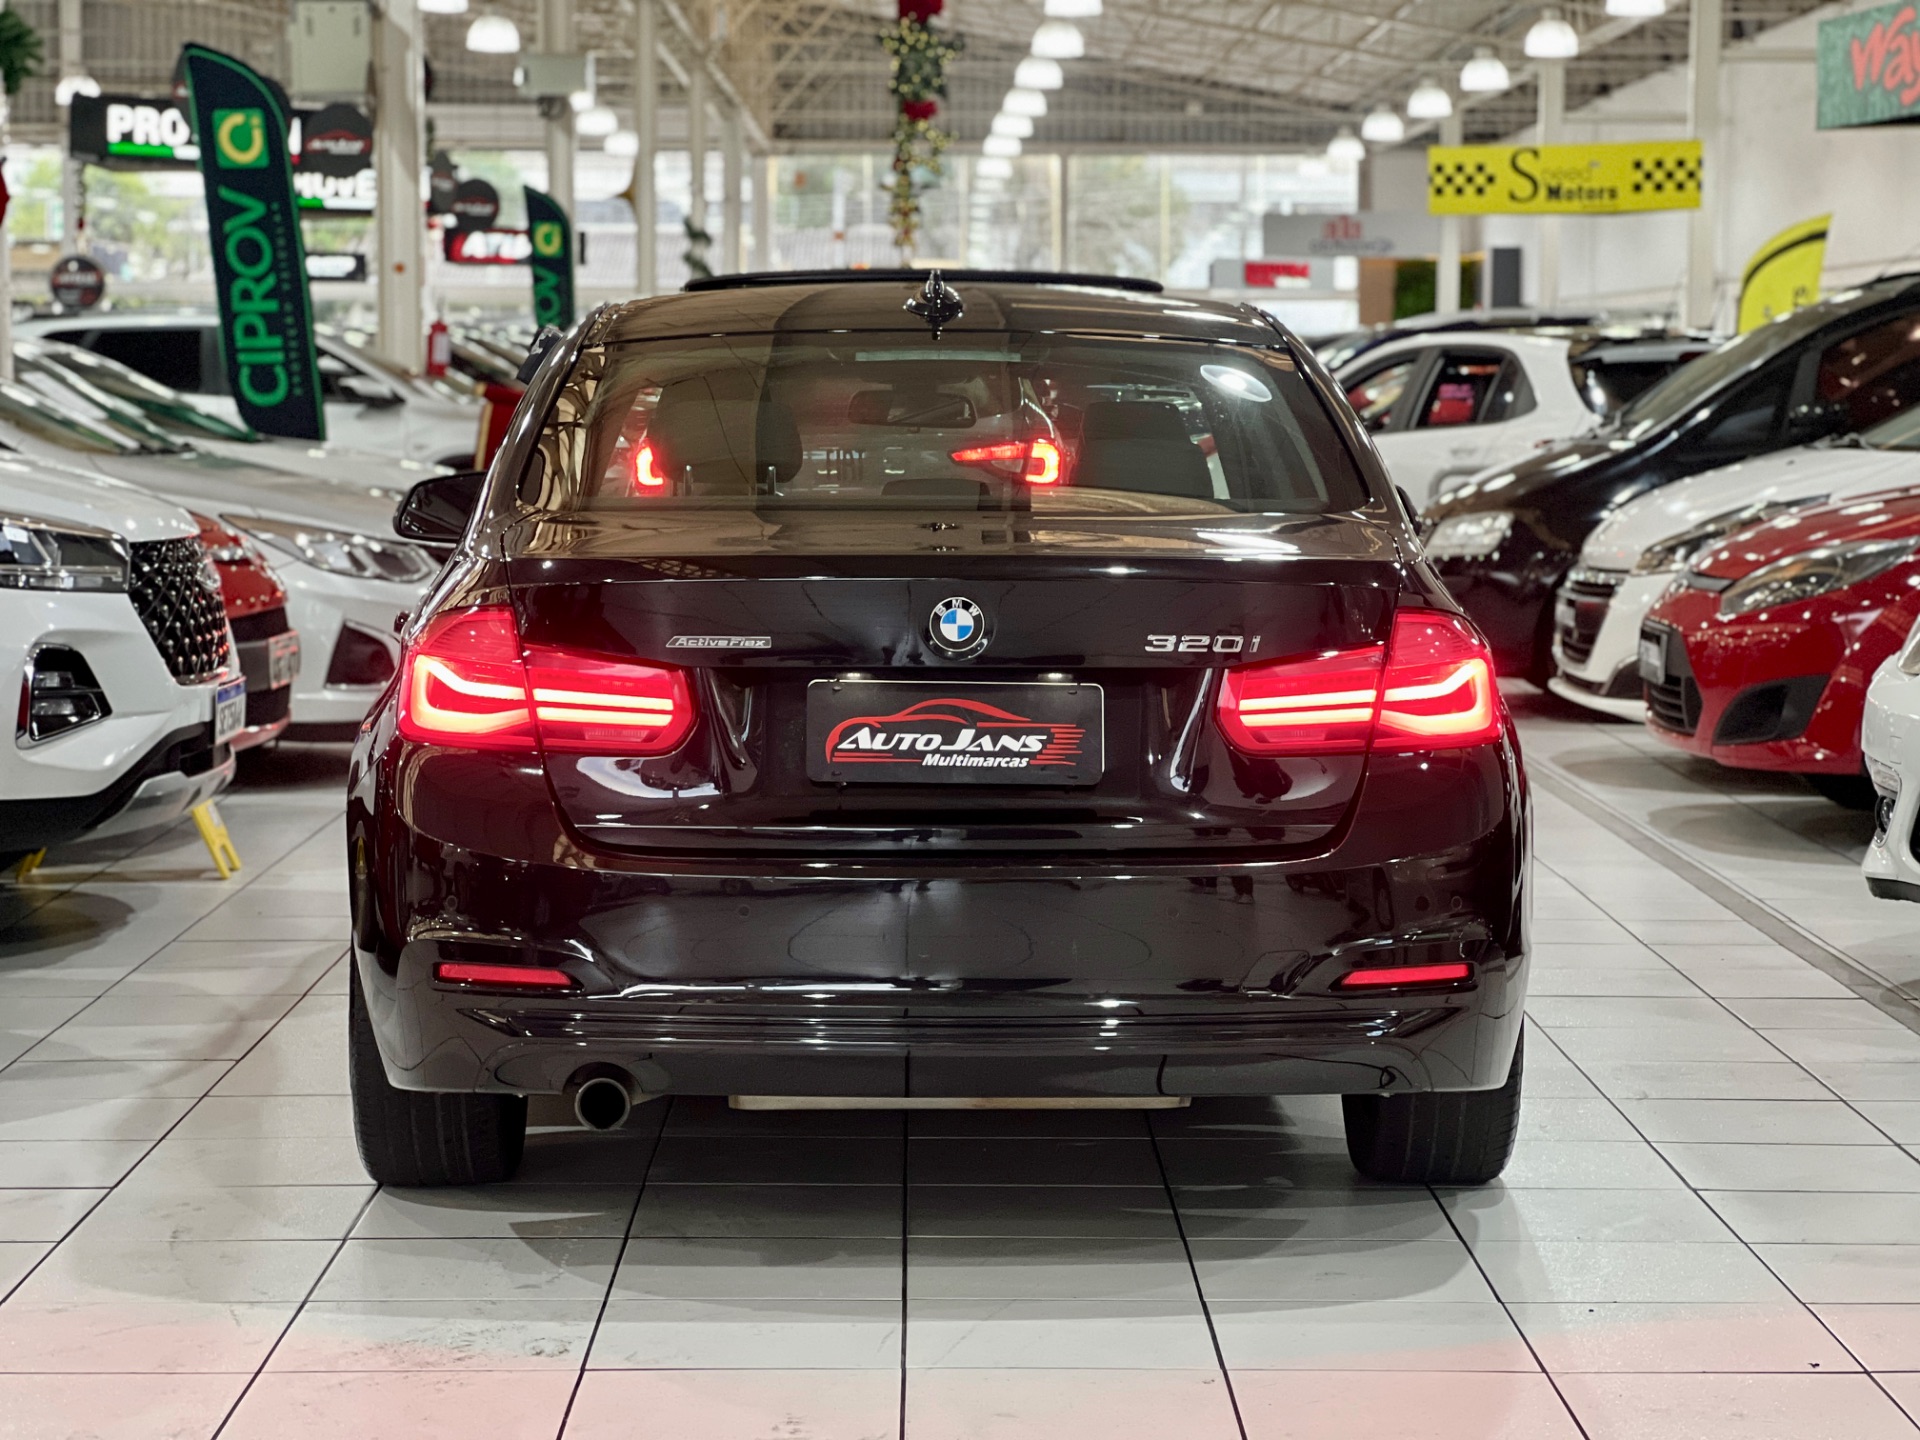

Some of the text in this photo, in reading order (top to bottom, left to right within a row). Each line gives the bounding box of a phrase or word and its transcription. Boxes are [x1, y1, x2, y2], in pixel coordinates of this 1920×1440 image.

[106, 103, 191, 147] PRO
[1545, 184, 1618, 203] Motors
[217, 184, 290, 407] CIPROV
[935, 598, 980, 617] BMW
[1144, 634, 1261, 653] 320i
[922, 753, 1029, 768] Multimarcas
